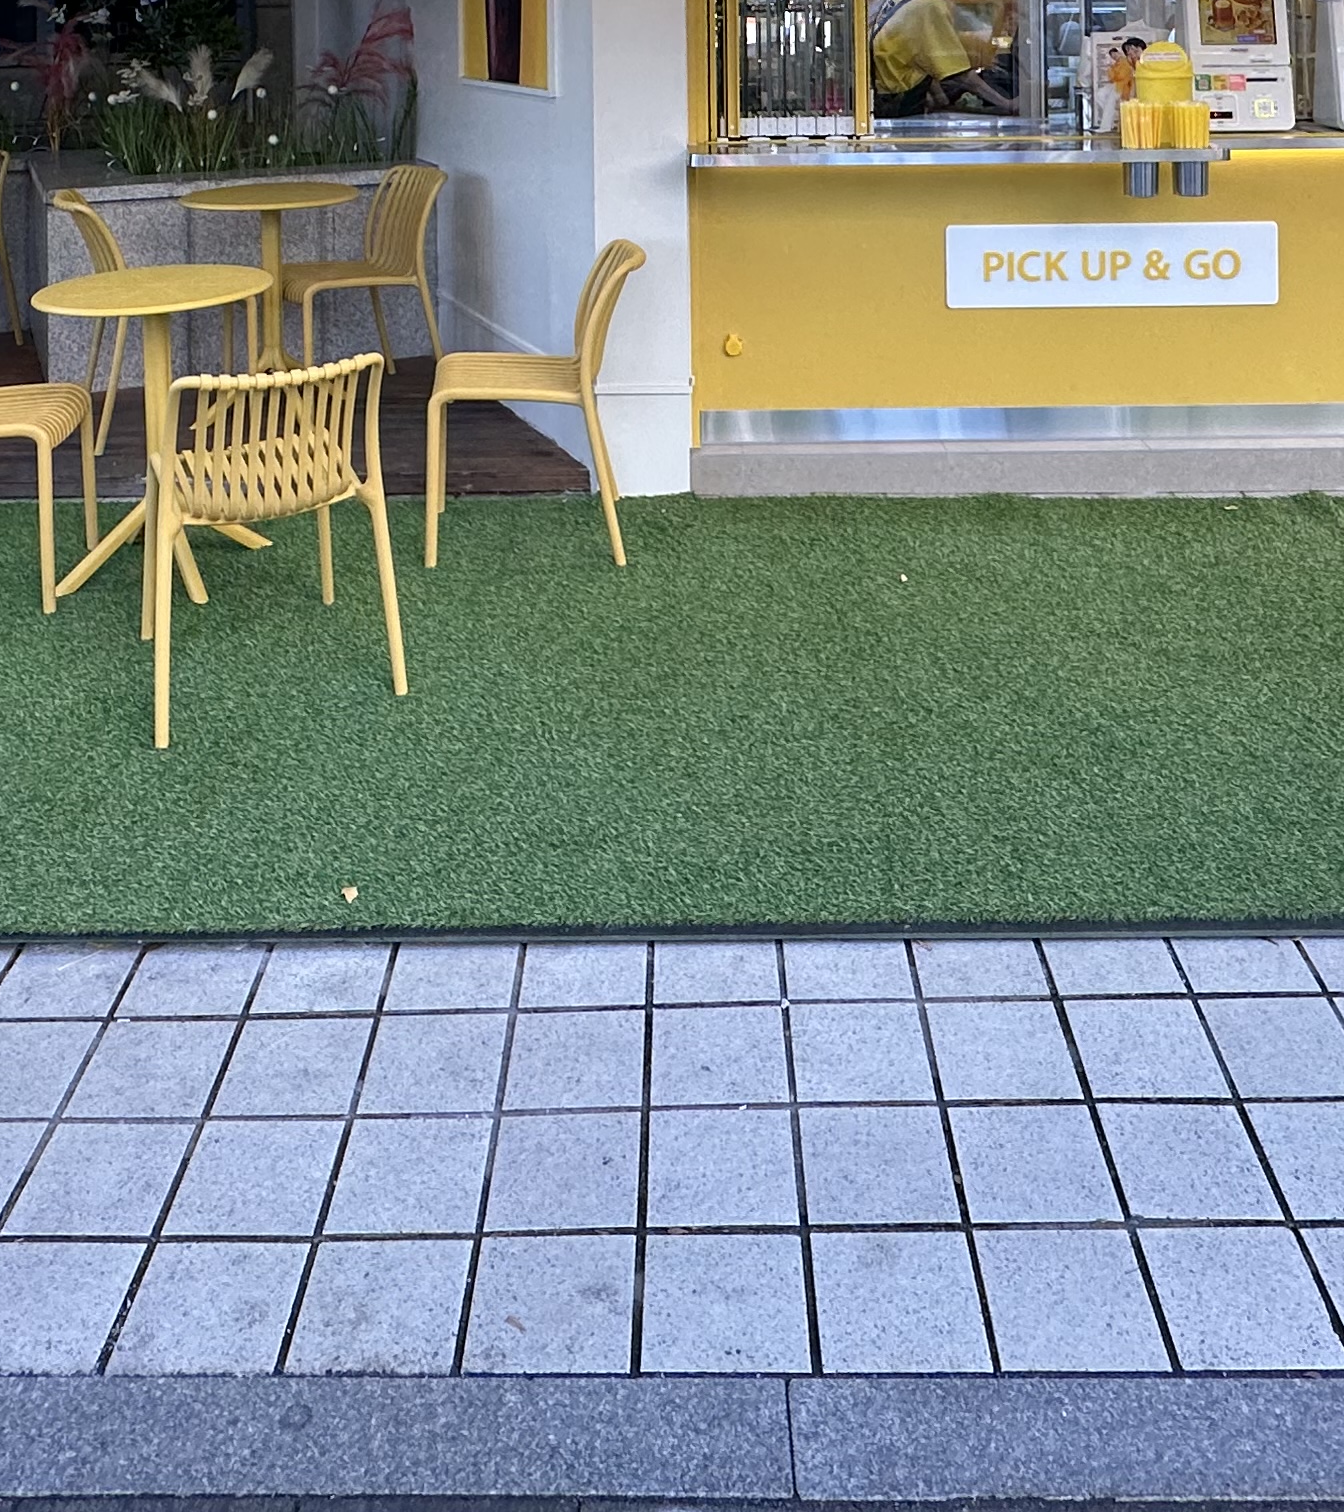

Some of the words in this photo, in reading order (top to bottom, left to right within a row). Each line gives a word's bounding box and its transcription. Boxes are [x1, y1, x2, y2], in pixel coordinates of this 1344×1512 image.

[982, 250, 1068, 282] PICK
[1081, 249, 1132, 281] UP
[1142, 249, 1170, 281] &
[1184, 248, 1241, 280] GO
